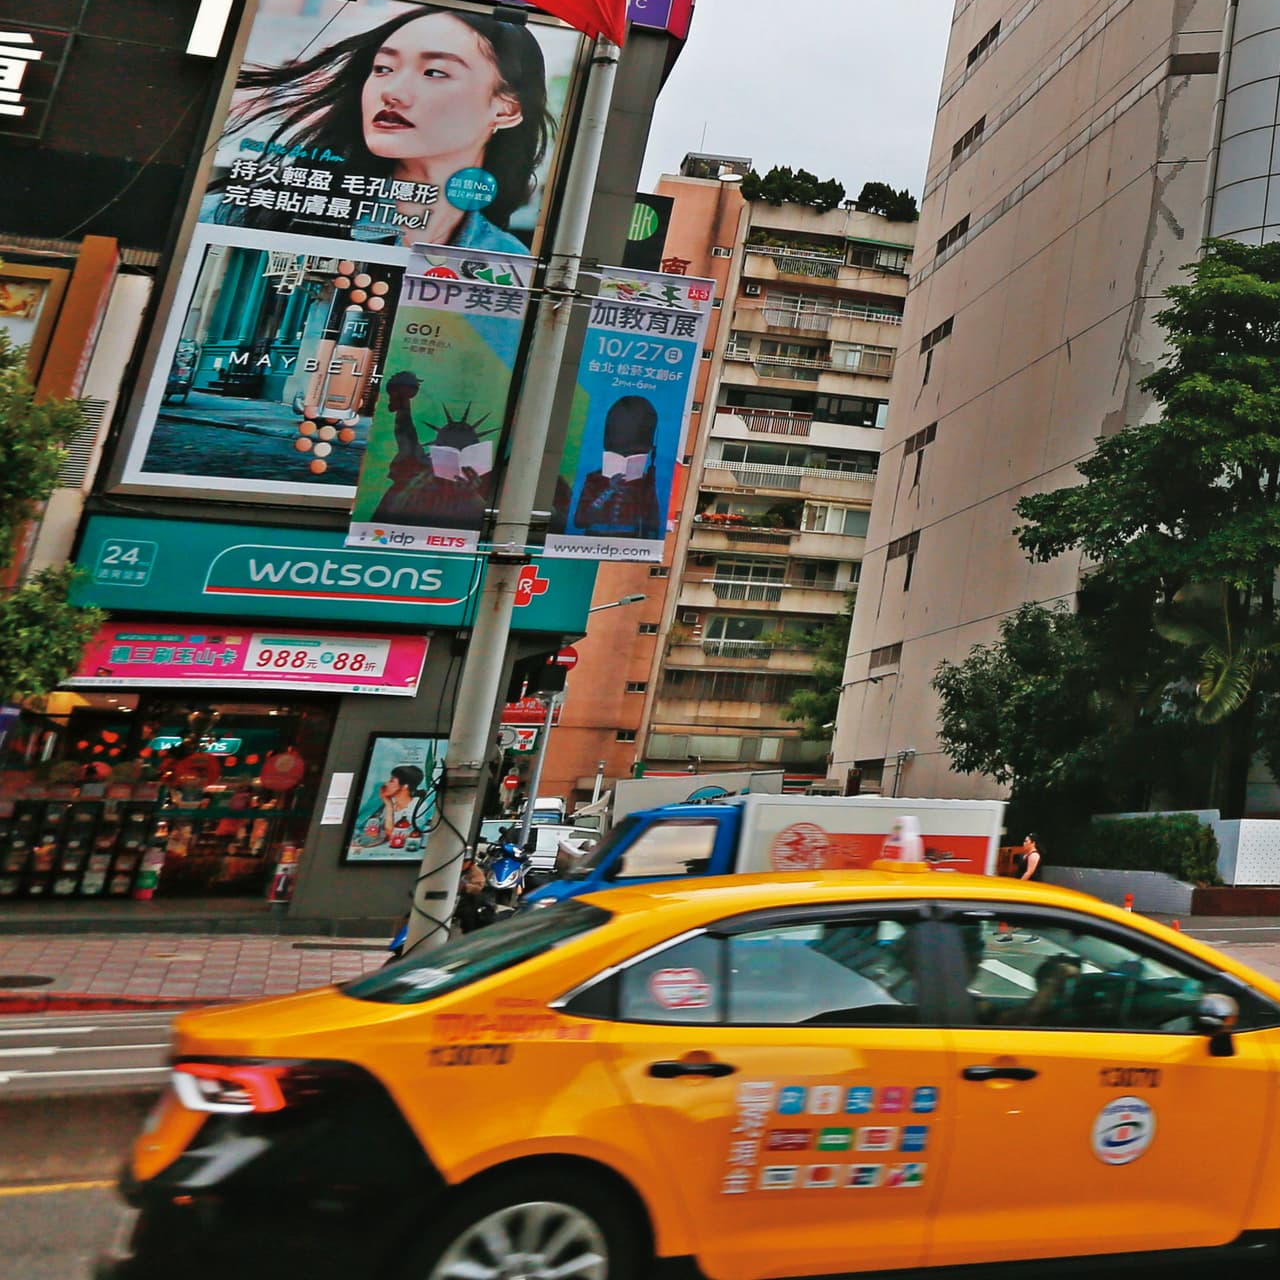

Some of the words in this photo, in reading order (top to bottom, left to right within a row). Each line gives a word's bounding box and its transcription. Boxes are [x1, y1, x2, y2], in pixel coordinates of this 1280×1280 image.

[229, 158, 334, 192] 持久輕盈
[340, 173, 440, 205] 毛孔隱形
[222, 184, 353, 220] 完美貼膚最
[406, 278, 462, 305] IDP
[464, 285, 523, 315] 英美
[406, 323, 441, 338] GO!
[591, 301, 699, 338] 加教育展
[599, 336, 664, 362] 10/27
[228, 351, 383, 378] MAYBELL
[588, 359, 614, 375] 台北
[388, 530, 415, 546] idp
[426, 535, 466, 548] IELTS
[553, 541, 651, 558] www.idp.com
[103, 545, 140, 565] 24
[249, 558, 443, 591] watsons
